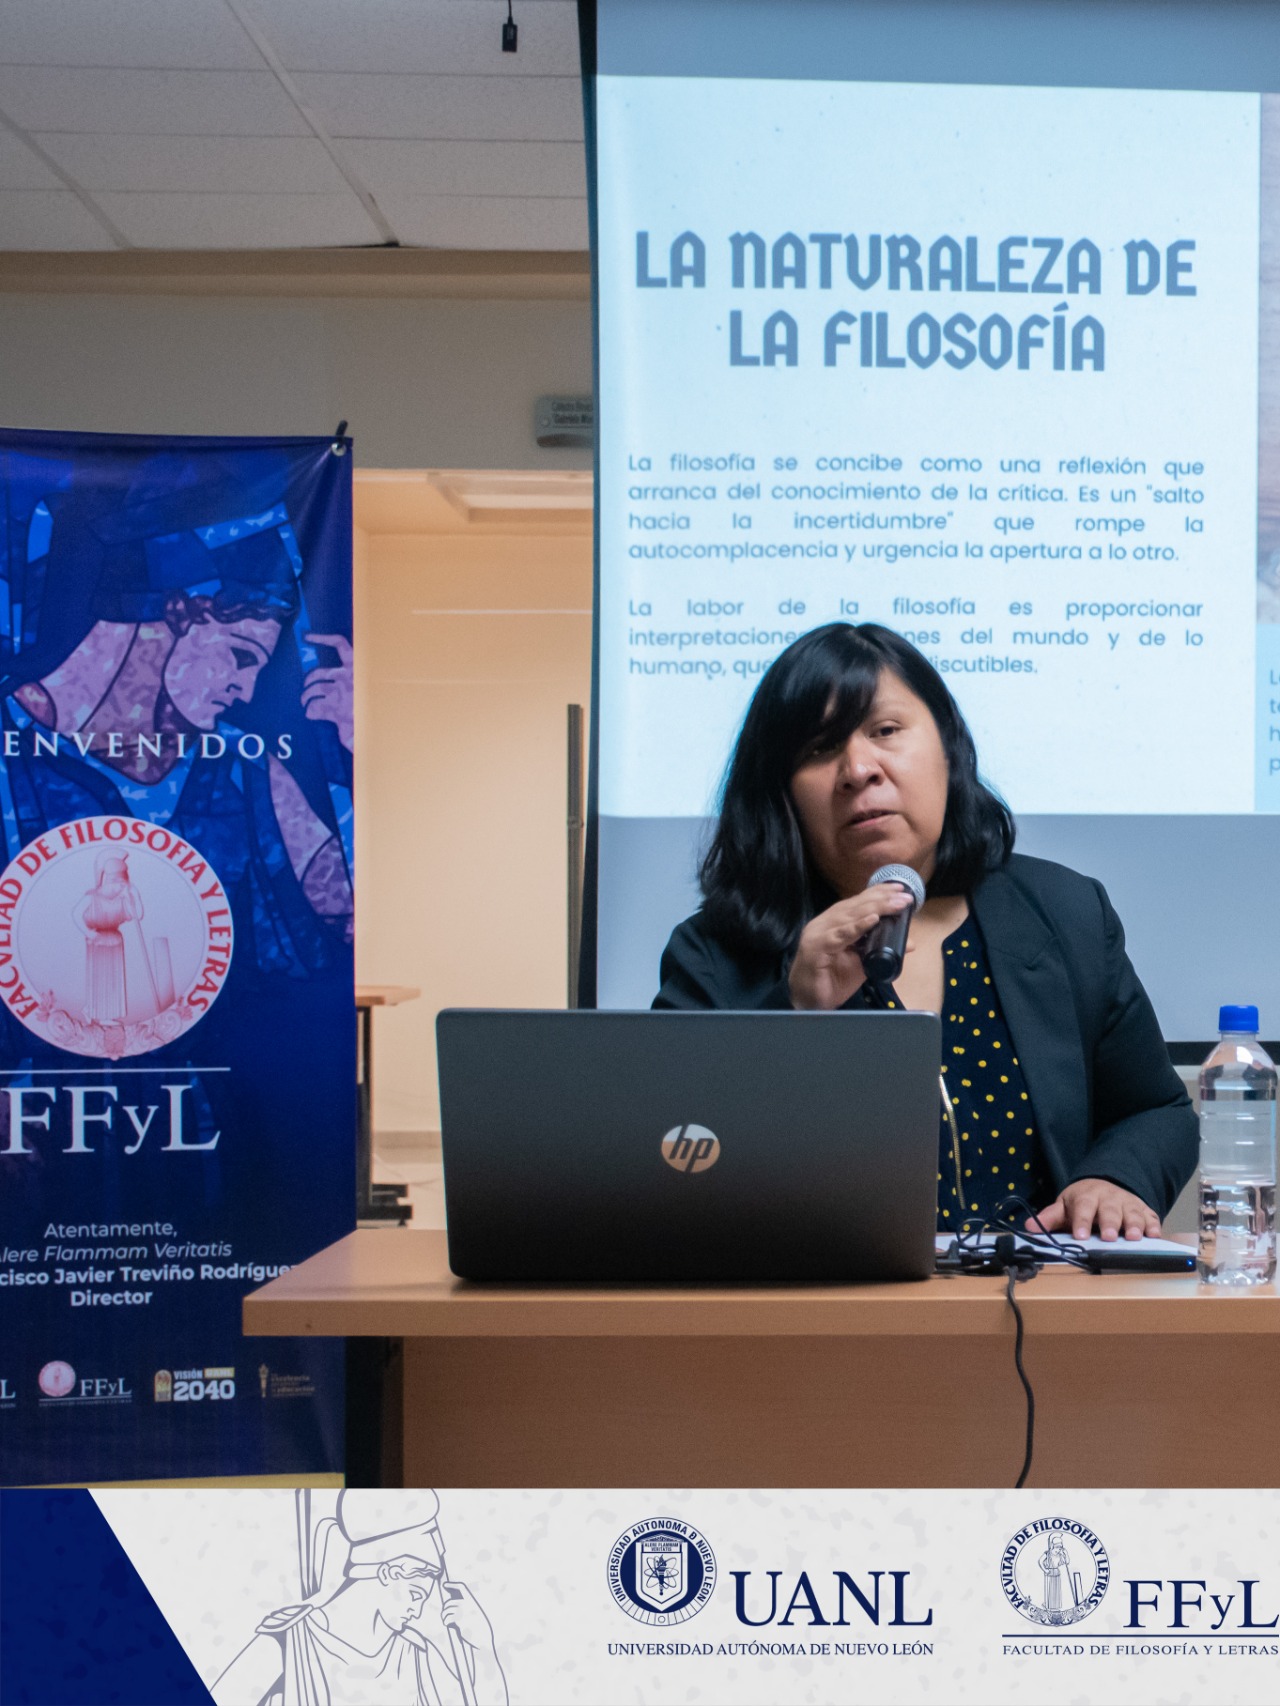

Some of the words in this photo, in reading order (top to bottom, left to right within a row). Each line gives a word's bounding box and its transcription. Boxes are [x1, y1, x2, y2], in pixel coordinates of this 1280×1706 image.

[636, 231, 706, 288] LA
[729, 231, 1101, 294] NATURALEZA
[1123, 239, 1197, 296] DE
[730, 310, 798, 366] LA
[824, 302, 1104, 371] FILOSOFÍA
[629, 454, 651, 472] La
[670, 453, 755, 472] filosofía
[774, 457, 798, 472] se
[816, 454, 902, 472] concibe
[921, 457, 982, 473] como
[1000, 458, 1040, 474] una
[1059, 456, 1146, 475] reflexión
[1164, 459, 1204, 480] que
[629, 485, 716, 501] arranca
[728, 483, 760, 501] del
[772, 483, 920, 502] conocimiento
[931, 484, 958, 502] de
[969, 484, 988, 502] la
[998, 483, 1068, 502] crítica.
[1079, 486, 1100, 502] Es
[1110, 488, 1136, 503] un
[1146, 485, 1204, 504] "salto
[629, 512, 690, 530] hacia
[732, 512, 752, 530] la
[794, 512, 953, 530] incertidumbre"
[994, 515, 1034, 536] que
[1075, 517, 1144, 537] rompe
[1186, 516, 1204, 533] la
[629, 541, 838, 563] autocomplacencia
[844, 542, 856, 562] y
[863, 541, 958, 562] urgencia
[965, 542, 984, 559] la
[990, 543, 1082, 564] apertura
[1088, 545, 1102, 560] a
[1109, 543, 1126, 560] lo
[1132, 544, 1178, 561] otro.
[629, 600, 652, 616] La
[687, 599, 744, 616] labor
[778, 598, 806, 616] de
[840, 598, 859, 616] la
[893, 598, 975, 616] filosofía
[1009, 600, 1032, 616] es
[1066, 600, 1203, 621] proporcionar
[629, 628, 802, 648] interpretacione
[961, 628, 992, 645] del
[1013, 628, 1088, 646] mundo
[1108, 631, 1120, 650] y
[1139, 630, 1165, 646] de
[1186, 630, 1203, 647] lo
[629, 658, 725, 678] humano,
[2, 730, 292, 760] ENVENIDOS
[16, 838, 57, 877] DE
[58, 818, 208, 881] FILOSOFIA
[199, 880, 225, 901] Y
[186, 907, 231, 1013] LETRAS
[0, 1084, 221, 1155] FFyL
[668, 1124, 716, 1173] hp
[44, 1222, 178, 1239] Atentamente,
[0, 1245, 39, 1263] lere
[44, 1243, 148, 1262] Flammam
[154, 1241, 232, 1260] Veritatis
[0, 1268, 49, 1286] cisco
[54, 1266, 114, 1285] Javier
[120, 1264, 195, 1284] Treviño
[200, 1261, 295, 1282] Rodrígue
[70, 1289, 152, 1307] Director
[80, 1377, 132, 1397] FFyL
[174, 1380, 235, 1401] 2040
